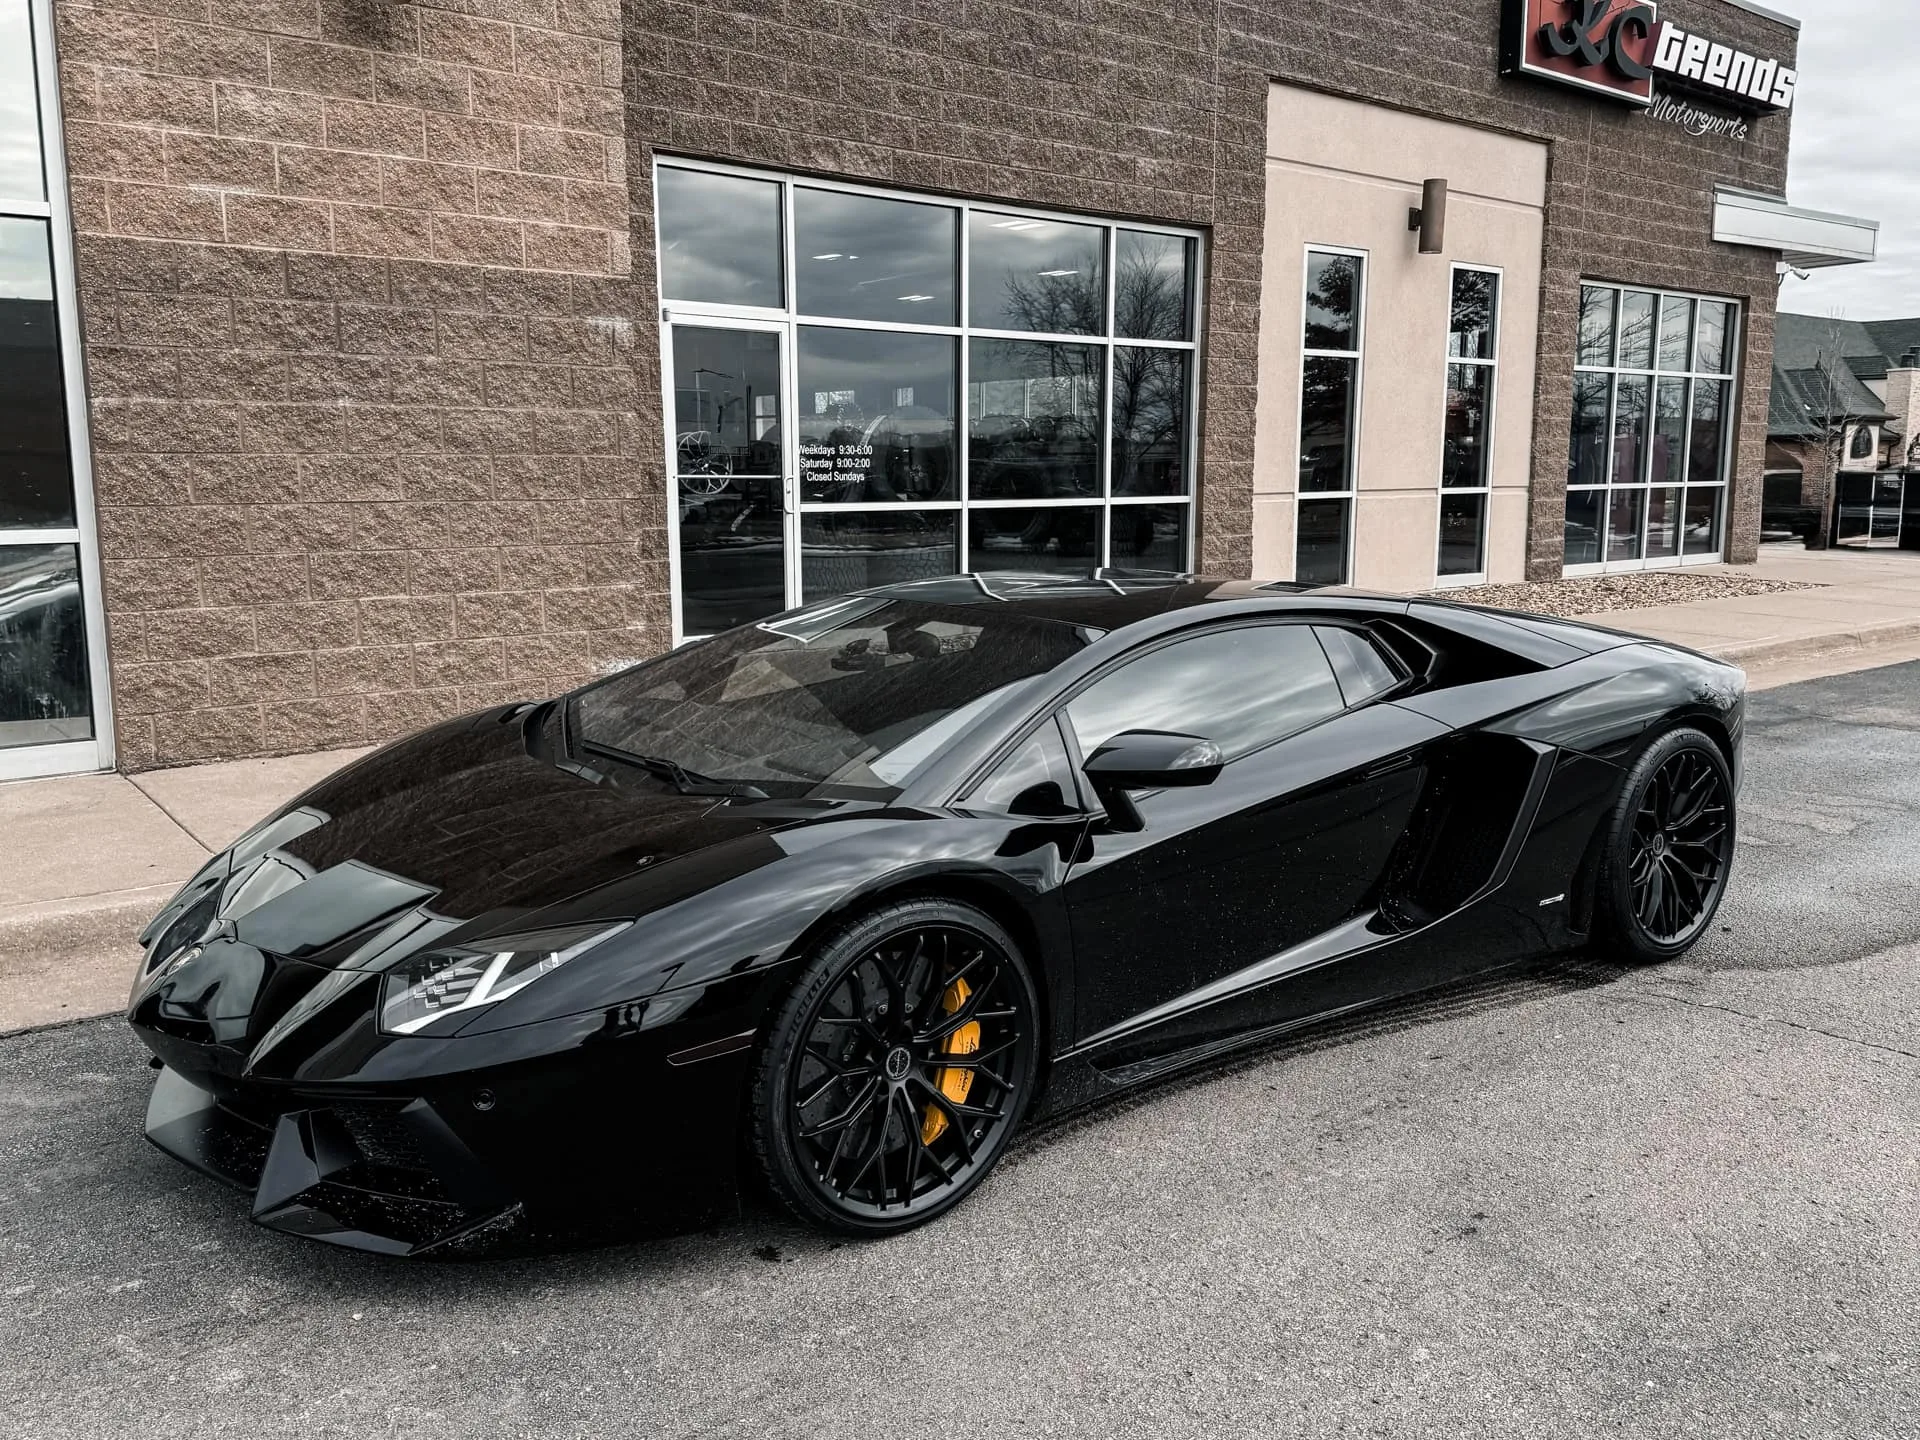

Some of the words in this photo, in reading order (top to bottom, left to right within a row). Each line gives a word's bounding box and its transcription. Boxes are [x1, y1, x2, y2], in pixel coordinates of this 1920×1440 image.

[1644, 91, 1748, 139] Motorsports
[798, 444, 836, 457] Weekdays
[838, 444, 873, 455] 9:30-6:00
[800, 458, 833, 470] Saturday
[836, 458, 871, 468] 9:00-2:00
[806, 471, 832, 481] Closed
[833, 471, 865, 483] Sundays
